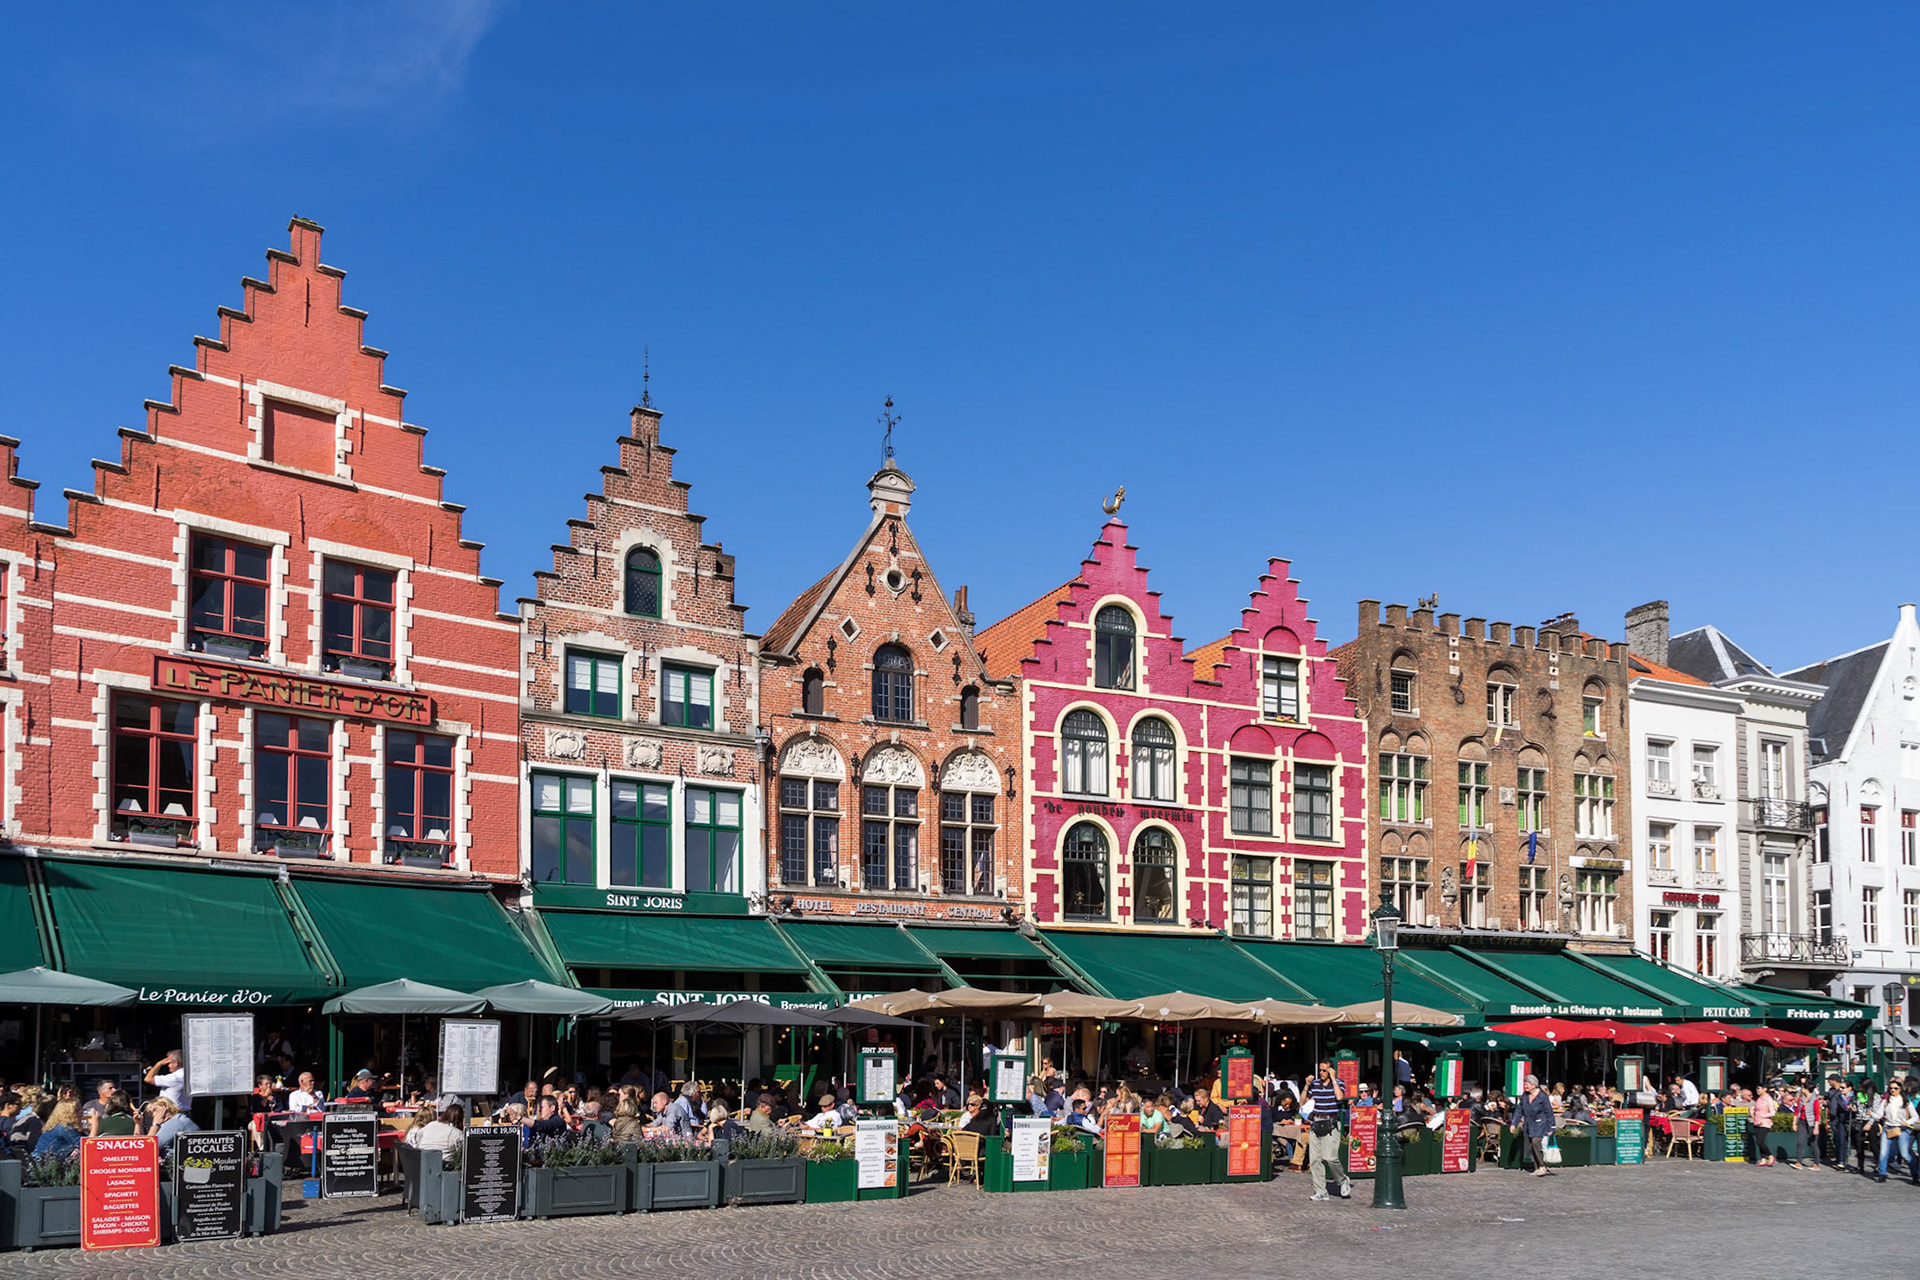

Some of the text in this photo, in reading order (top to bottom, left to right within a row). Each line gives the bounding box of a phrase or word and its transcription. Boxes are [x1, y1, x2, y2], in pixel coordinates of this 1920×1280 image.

[166, 667, 424, 721] LE PANIER D'OR
[606, 893, 683, 909] SINT JORIS
[796, 899, 994, 919] HOTEL RESTAURANT CENTRAL
[139, 987, 273, 1004] Le Panier d'Or
[1510, 1005, 1551, 1014] Brasserie
[1558, 1005, 1568, 1014] La
[1599, 1006, 1616, 1016] d'Or
[1622, 1007, 1663, 1016] Restaurant
[1703, 1007, 1727, 1017] PETIT
[1786, 1009, 1863, 1019] Friterie 1900
[500, 1127, 517, 1135] 19,50
[96, 1139, 145, 1150] SNACKS
[188, 1144, 234, 1154] LOCALES
